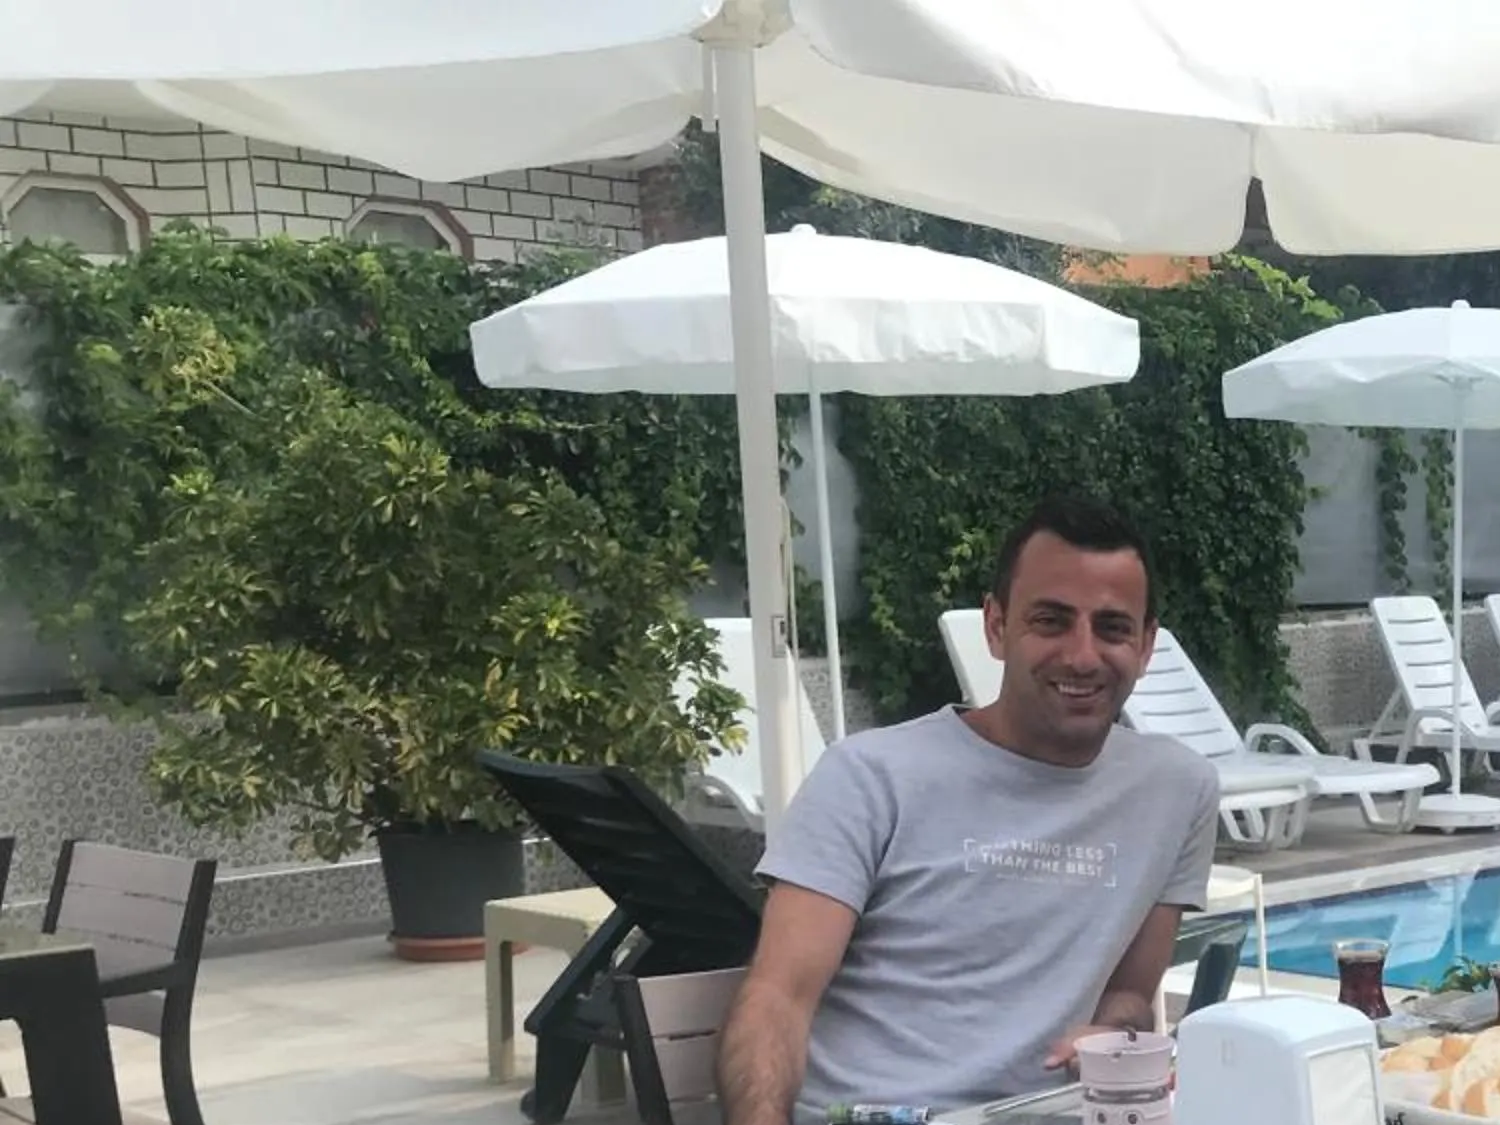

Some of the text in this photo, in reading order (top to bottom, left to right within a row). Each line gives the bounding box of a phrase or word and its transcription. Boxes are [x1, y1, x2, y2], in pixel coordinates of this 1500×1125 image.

[980, 845, 1104, 878] THAN THE BEST
[1066, 846, 1105, 863] LESS
